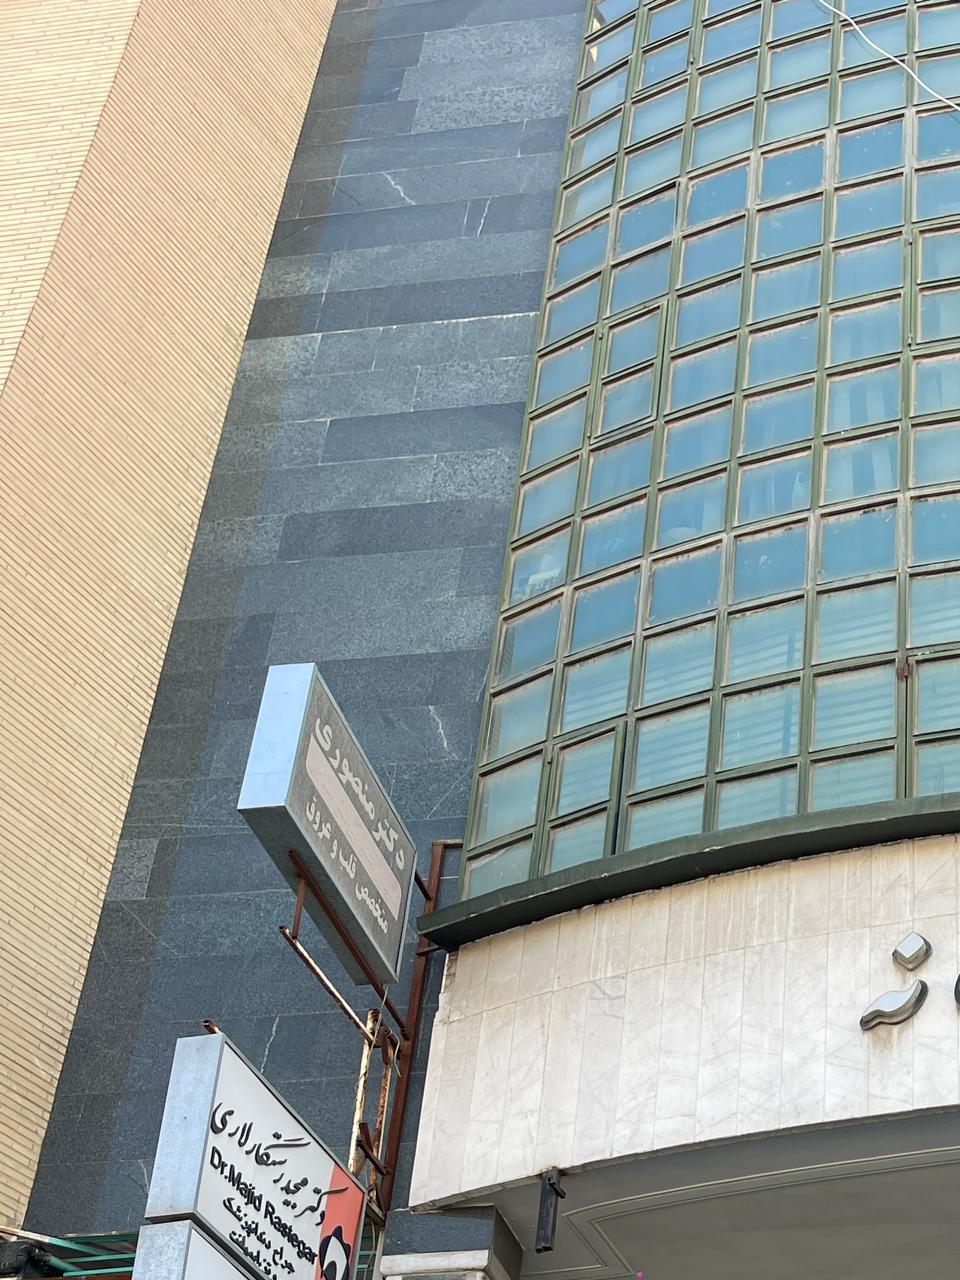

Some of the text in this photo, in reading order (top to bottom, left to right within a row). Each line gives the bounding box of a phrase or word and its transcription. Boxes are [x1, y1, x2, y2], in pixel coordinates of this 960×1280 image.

[315, 716, 405, 871] دکتر منصوری
[304, 795, 389, 934] متخصص قلب و عروق
[209, 1102, 254, 1148] لاری
[279, 1176, 310, 1210] مجید
[293, 1186, 349, 1226] دکتر
[264, 1200, 319, 1265] Rastegar
